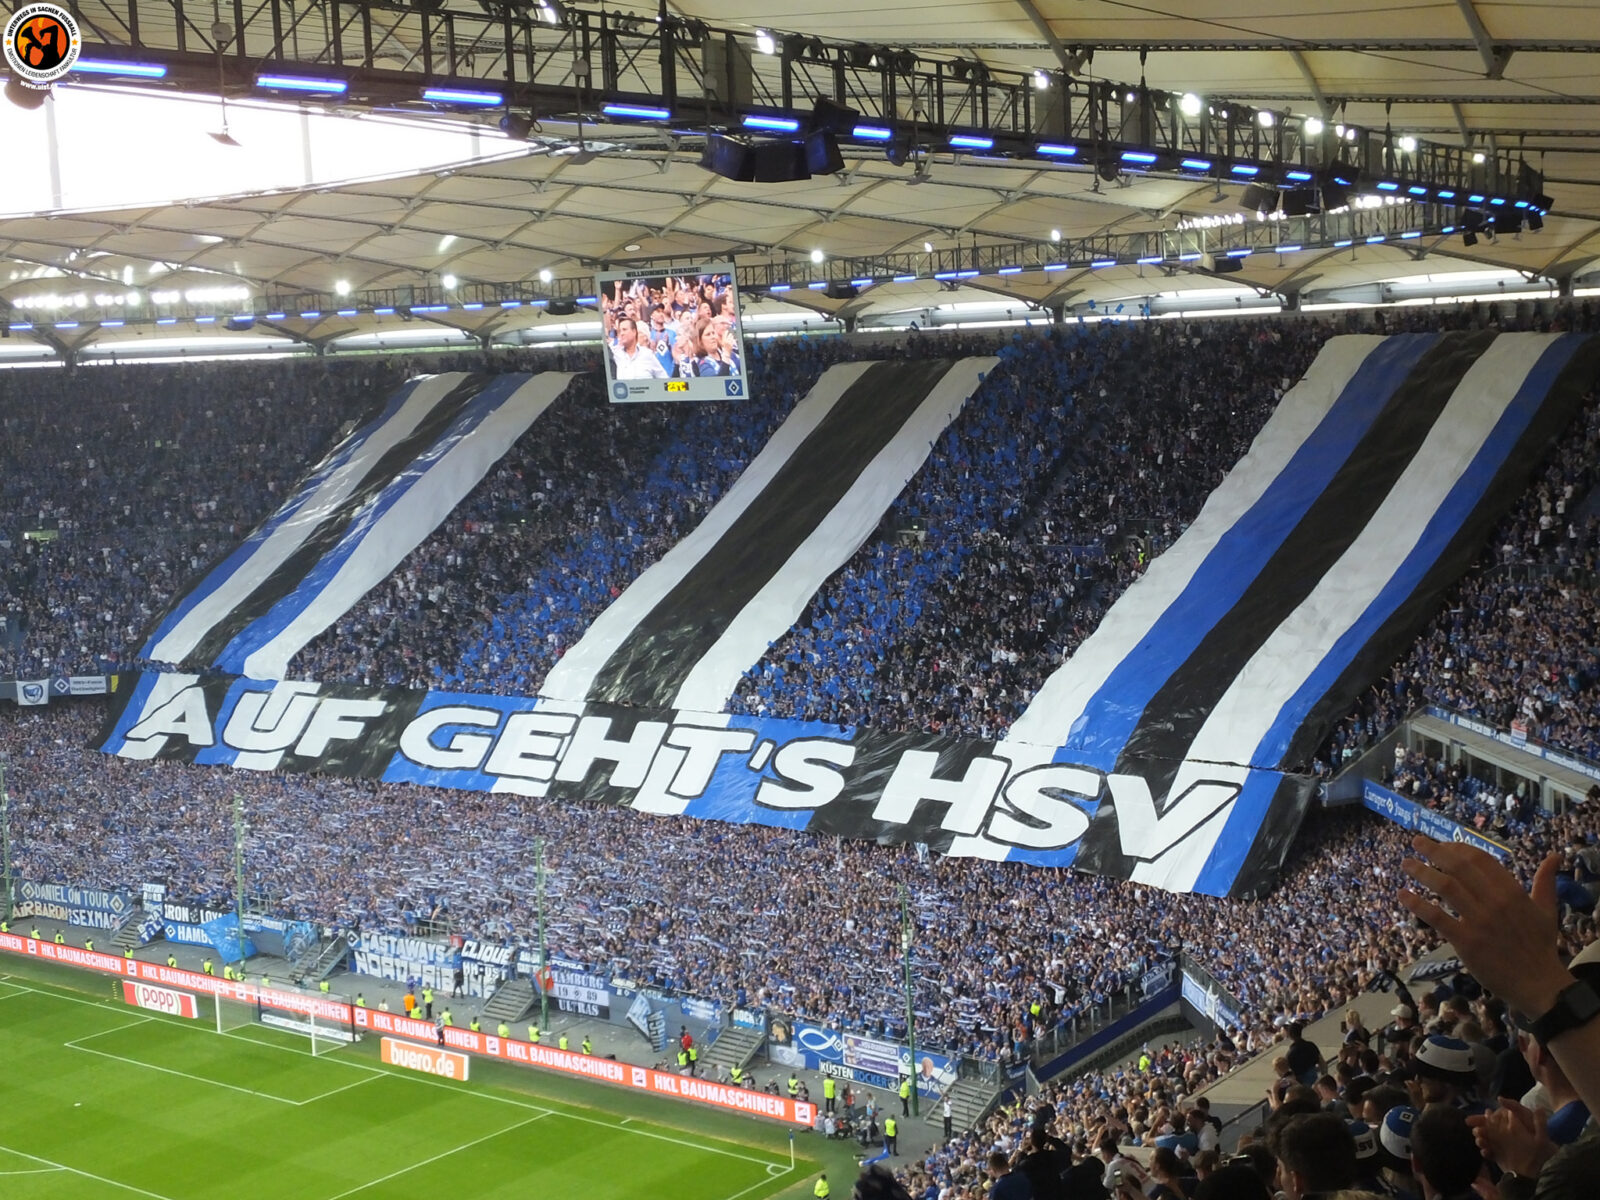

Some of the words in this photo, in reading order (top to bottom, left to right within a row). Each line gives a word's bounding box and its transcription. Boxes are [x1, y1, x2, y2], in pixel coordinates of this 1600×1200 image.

[124, 685, 388, 758] AUF
[399, 704, 857, 811] GEHT'S
[871, 749, 1243, 863] HSV
[35, 884, 67, 903] DANIEL
[68, 888, 81, 905] ON
[83, 890, 110, 909] TOUR
[177, 925, 214, 945] HAMB
[361, 932, 447, 963] CASTAWAYS
[41, 943, 56, 958] HKL
[56, 947, 122, 972] BAUMASCHINEN
[461, 940, 511, 966] CLIQUE
[142, 964, 159, 980] HKL
[160, 968, 230, 995] BAUMASCHINEN
[552, 970, 604, 990] HAMBURG
[558, 986, 569, 998] 19
[586, 990, 598, 1002] 89
[558, 999, 600, 1016] ULTRAS
[373, 1013, 393, 1031] HKL
[394, 1017, 479, 1050] BAUMASHINEN
[390, 1039, 456, 1078] buero.de
[506, 1042, 528, 1060] HKL
[529, 1045, 624, 1081] BAUMASCHINEN
[654, 1073, 679, 1094] HKL
[680, 1078, 785, 1117] BAUMASCHINEN
